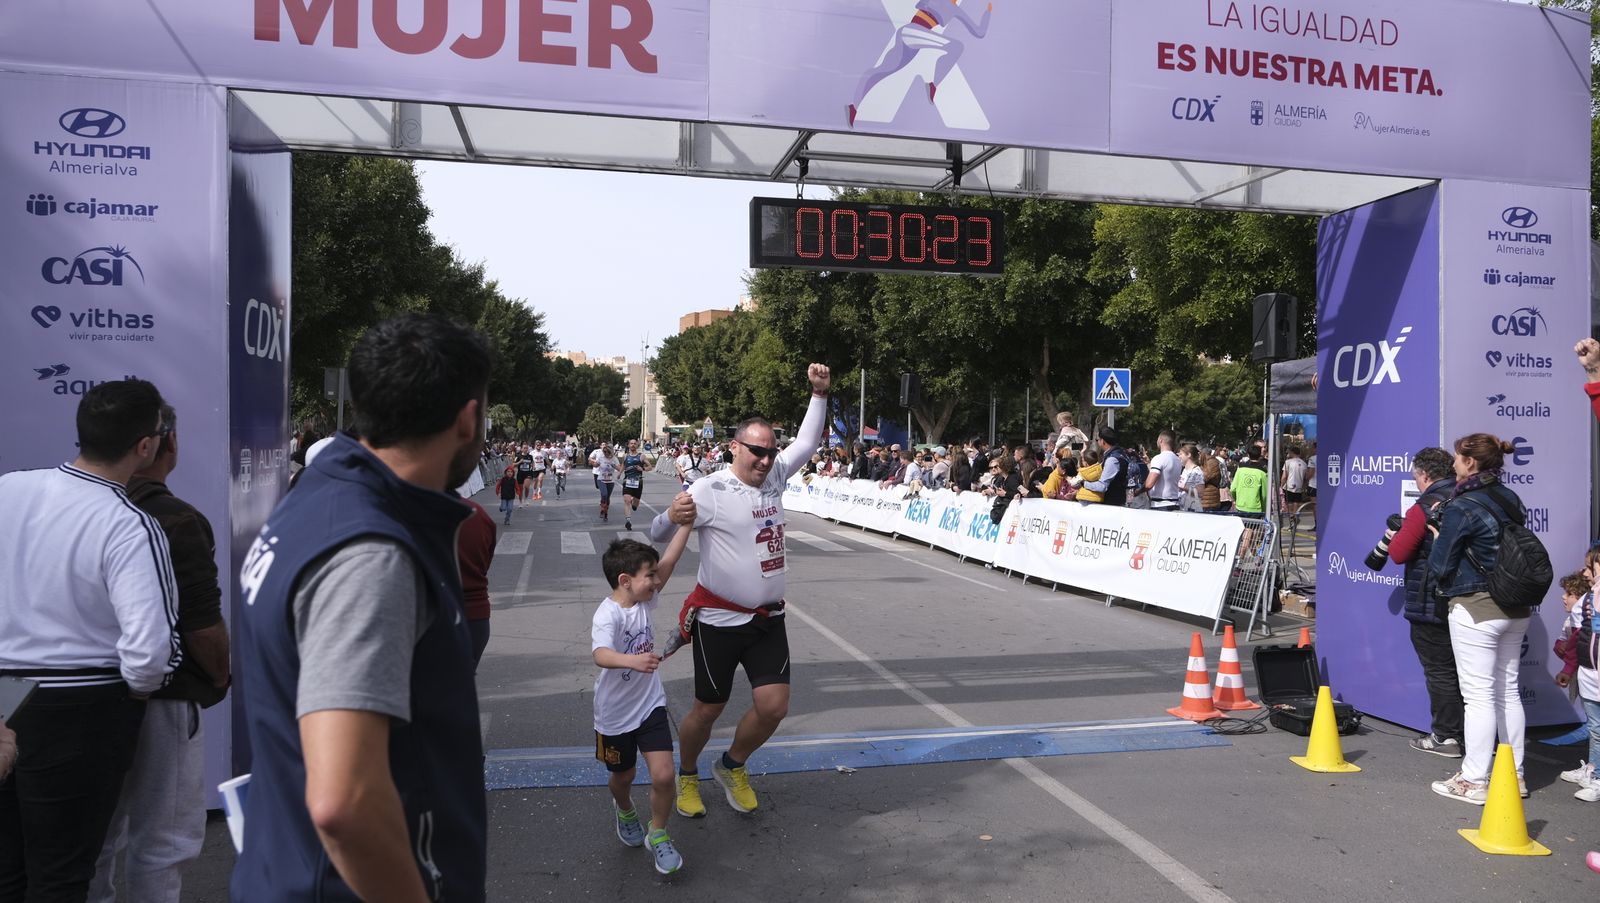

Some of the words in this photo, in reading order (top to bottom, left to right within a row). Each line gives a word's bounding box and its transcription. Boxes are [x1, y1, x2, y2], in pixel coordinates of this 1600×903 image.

[1207, 0, 1243, 30] LA
[1253, 4, 1399, 47] IGUALDAD
[254, 0, 657, 73] MUJER
[1157, 42, 1197, 72] ES
[1205, 46, 1348, 89] NUESTRA
[1354, 63, 1443, 97] META.
[1172, 95, 1221, 123] CDX
[1274, 104, 1327, 120] ALMERÍA
[1274, 117, 1301, 128] CIUDAD
[34, 141, 151, 160] HYUNDAI
[49, 160, 138, 176] Almerialva
[63, 197, 159, 219] cajamar
[796, 207, 992, 266] 00:30:23
[1488, 230, 1552, 245] HYUNDAI
[1496, 244, 1545, 256] Almerialva
[41, 256, 124, 287] CASI
[1504, 272, 1556, 287] cajamar
[69, 308, 154, 329] vithas
[1491, 314, 1537, 337] CASI
[69, 332, 90, 340] vivir
[92, 333, 113, 342] para
[115, 333, 154, 342] cuidarte
[244, 298, 285, 362] CDX
[1333, 327, 1412, 388] CDX
[1506, 352, 1553, 368] vithas
[1496, 402, 1551, 421] aqualia
[1351, 474, 1384, 485] CIUDAD
[751, 506, 778, 519] MUJER
[1075, 525, 1130, 550] ALMERÍA
[1158, 536, 1227, 563] ALMERÍA
[1157, 558, 1190, 575] CIUDAD
